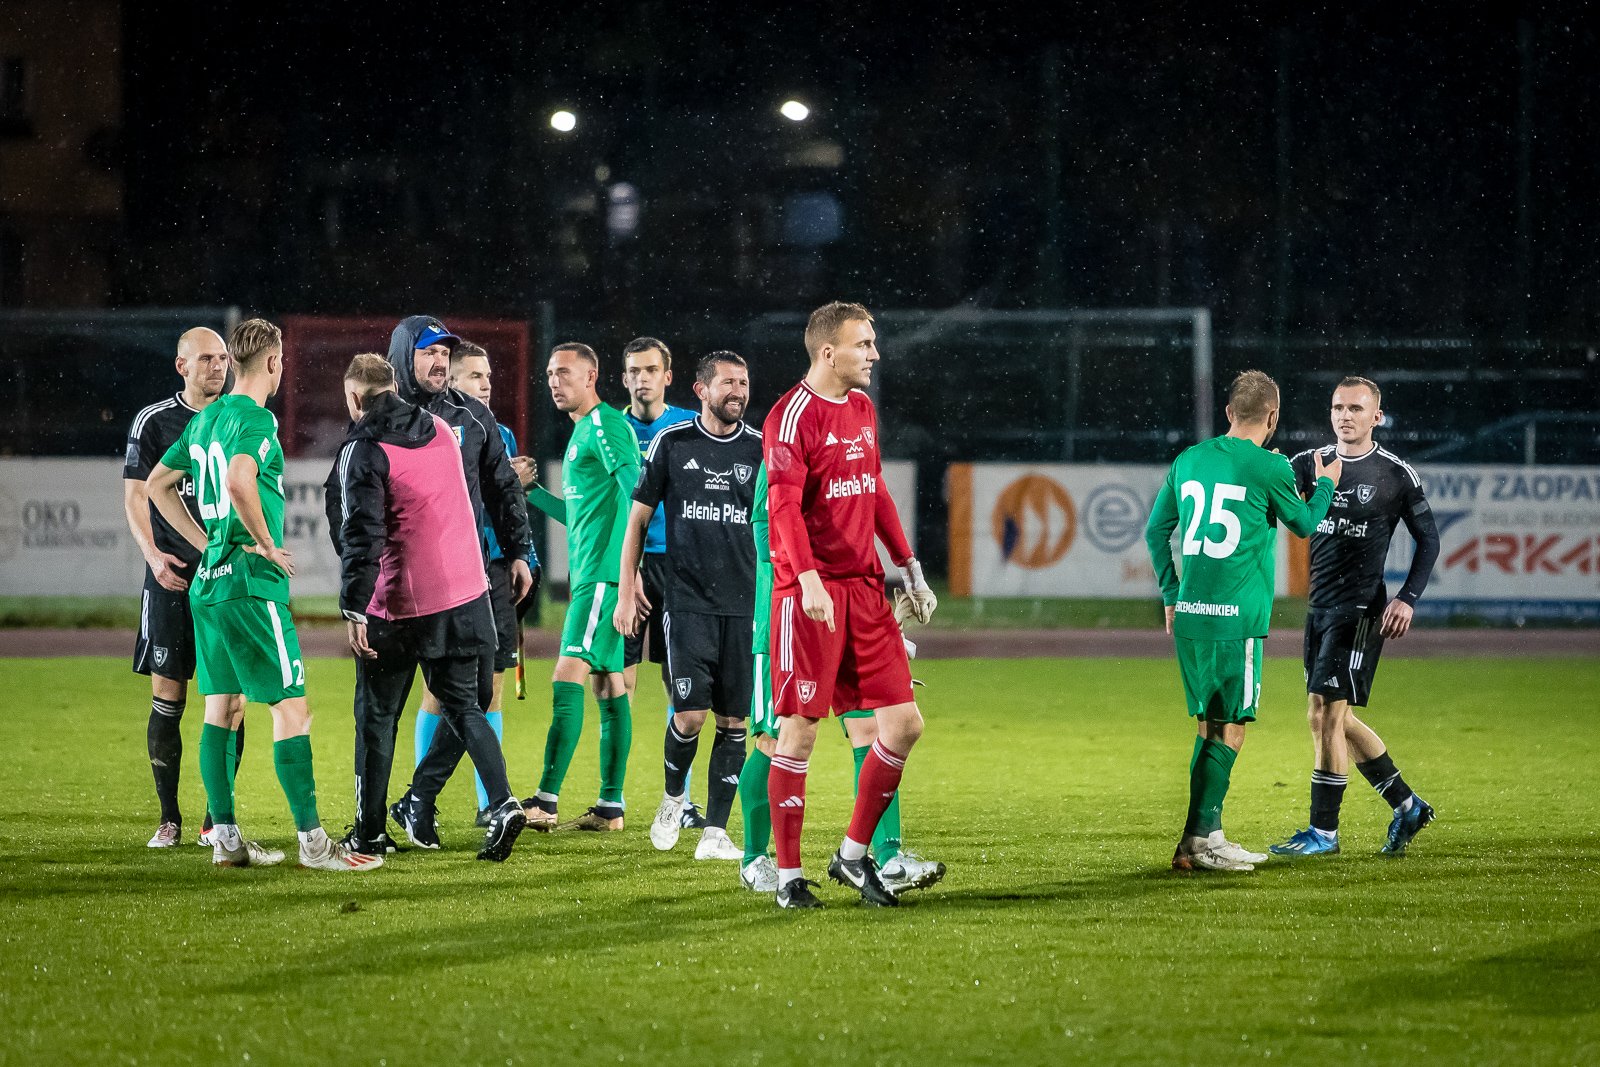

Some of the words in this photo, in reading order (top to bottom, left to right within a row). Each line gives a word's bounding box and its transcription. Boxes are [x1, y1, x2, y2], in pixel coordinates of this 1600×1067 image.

[177, 477, 195, 497] Jel
[189, 441, 231, 520] 20
[825, 477, 861, 499] Jelenia
[862, 472, 876, 494] Pla
[1418, 472, 1481, 499] OWY
[682, 500, 721, 522] Jelenia
[723, 503, 748, 525] Plast
[1181, 480, 1247, 559] 25
[1337, 517, 1368, 538] Plast
[1444, 532, 1600, 574] ARKA
